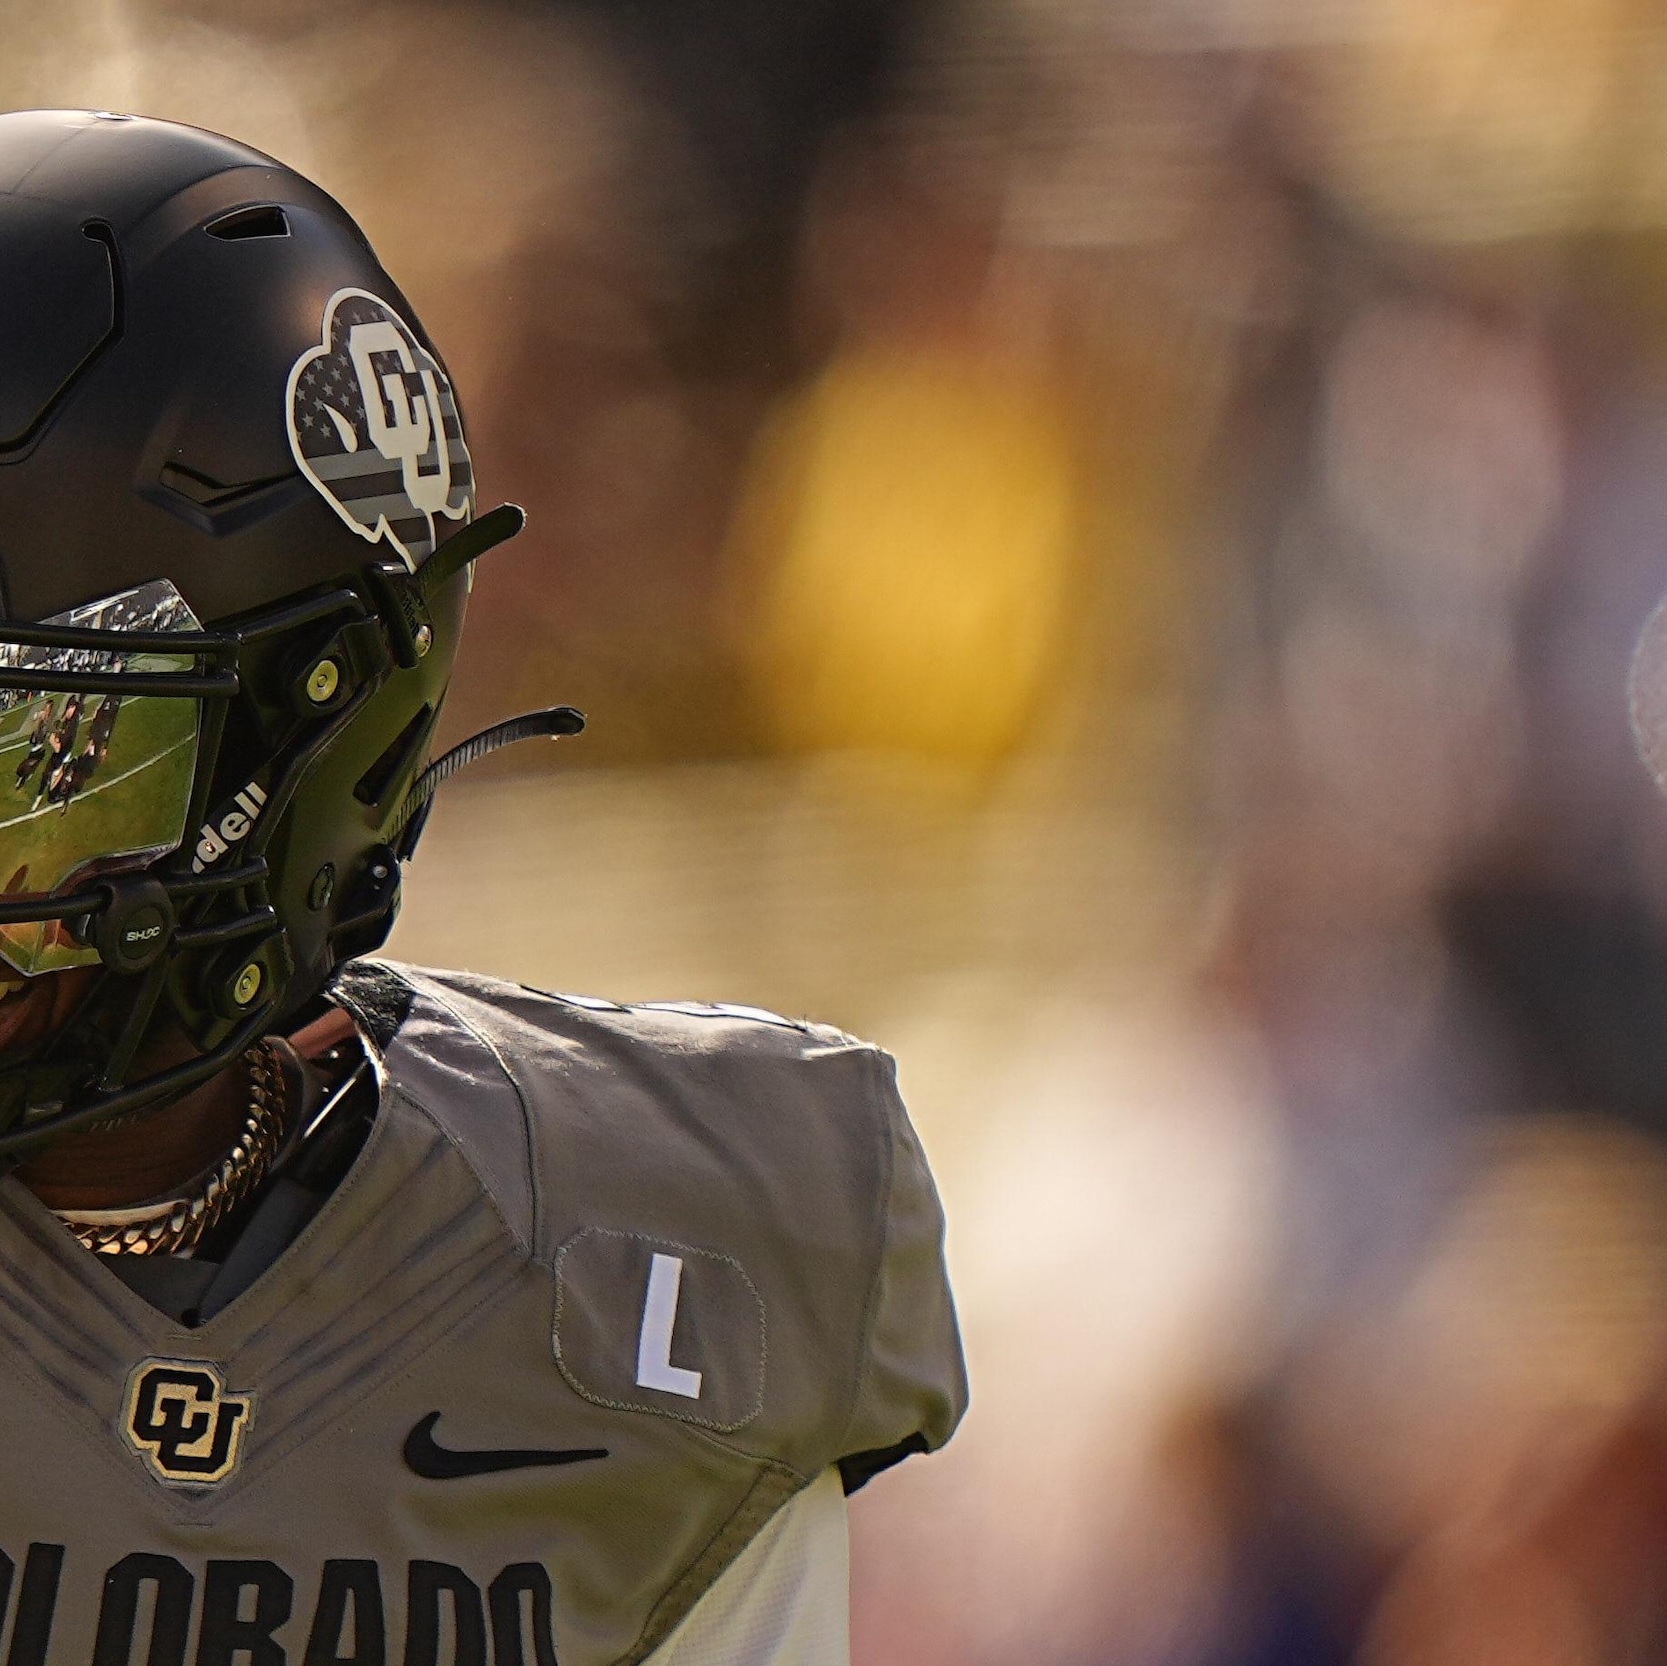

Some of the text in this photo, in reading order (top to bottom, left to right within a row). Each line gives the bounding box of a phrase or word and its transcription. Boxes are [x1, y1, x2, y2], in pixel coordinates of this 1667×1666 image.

[350, 321, 450, 511] CU
[636, 1252, 701, 1399] L
[129, 1365, 247, 1478] CU
